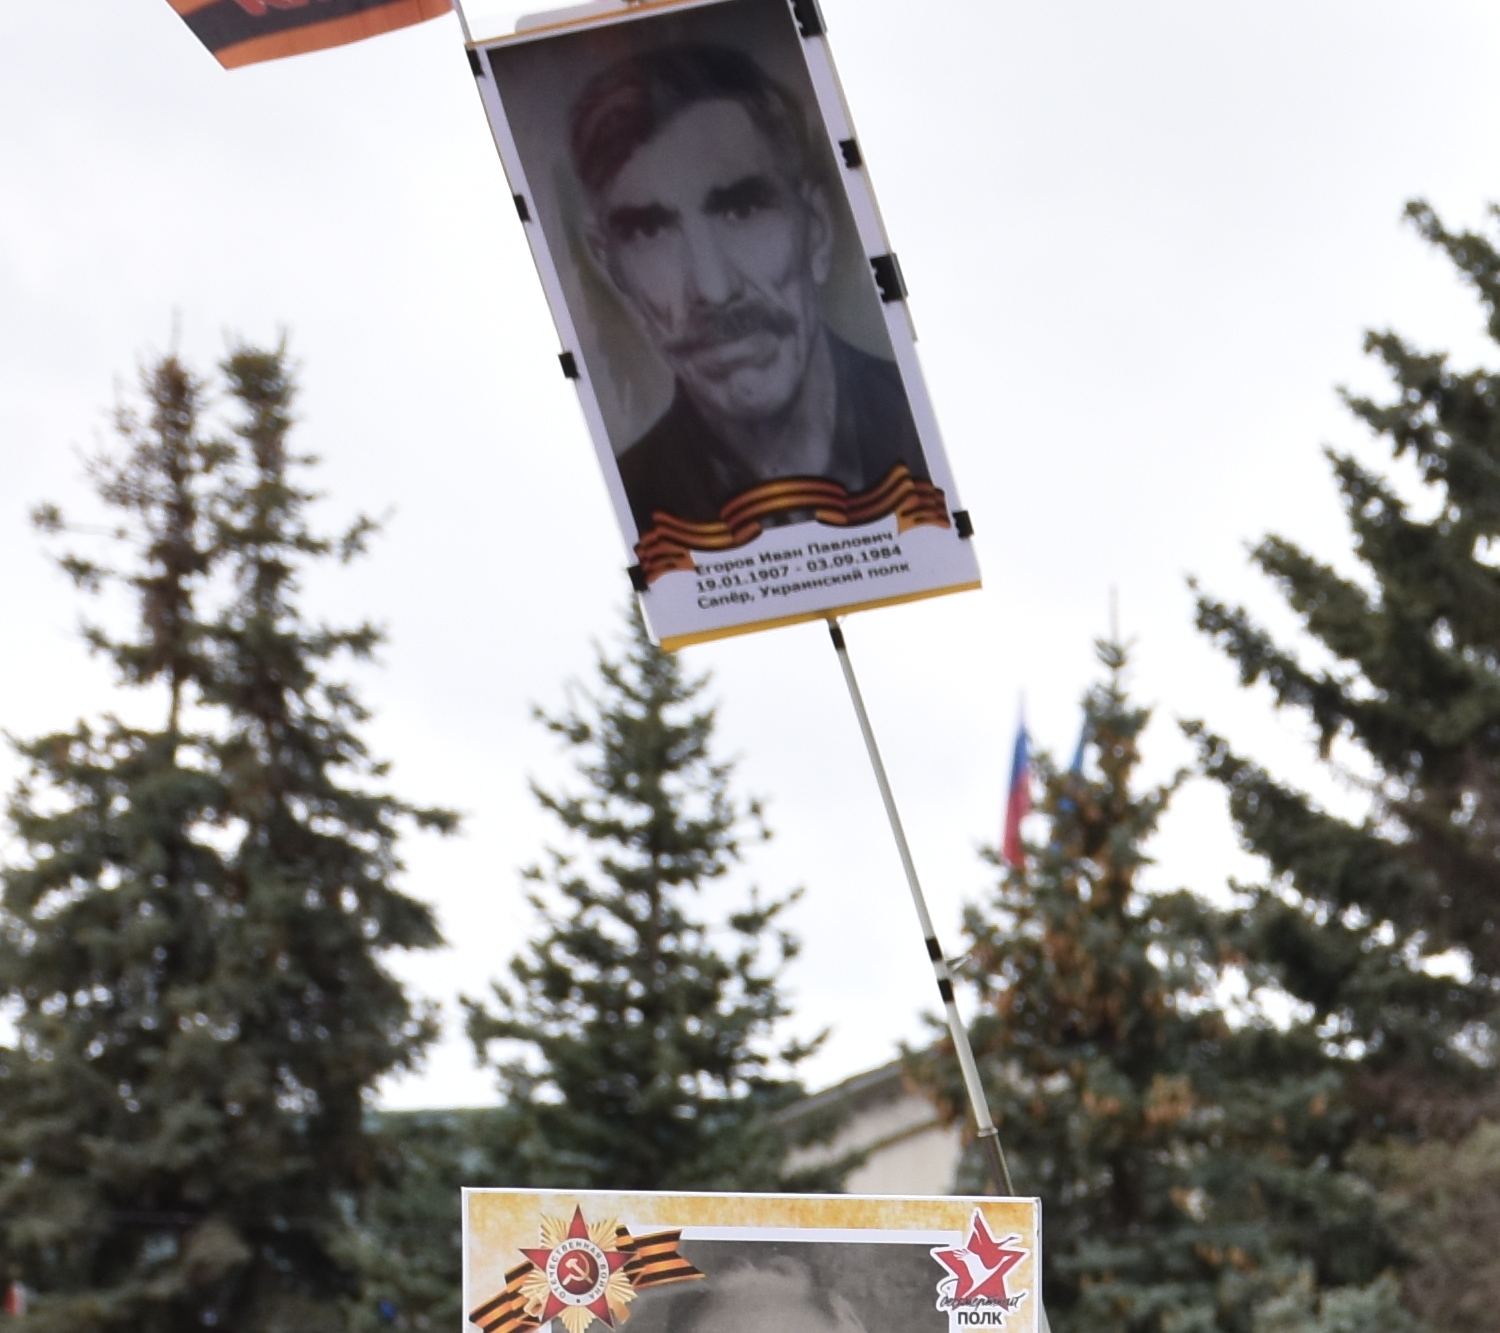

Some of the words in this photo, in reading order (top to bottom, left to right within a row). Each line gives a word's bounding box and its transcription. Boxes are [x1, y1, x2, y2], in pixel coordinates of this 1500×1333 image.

[759, 547, 803, 566] Иван
[807, 531, 893, 556] Павлович
[696, 566, 790, 593] 19.01.1907
[807, 544, 903, 574] 03.09.1984
[760, 569, 864, 599] Украинский
[869, 561, 911, 579] полк
[957, 1311, 1003, 1325] ПОЛК
